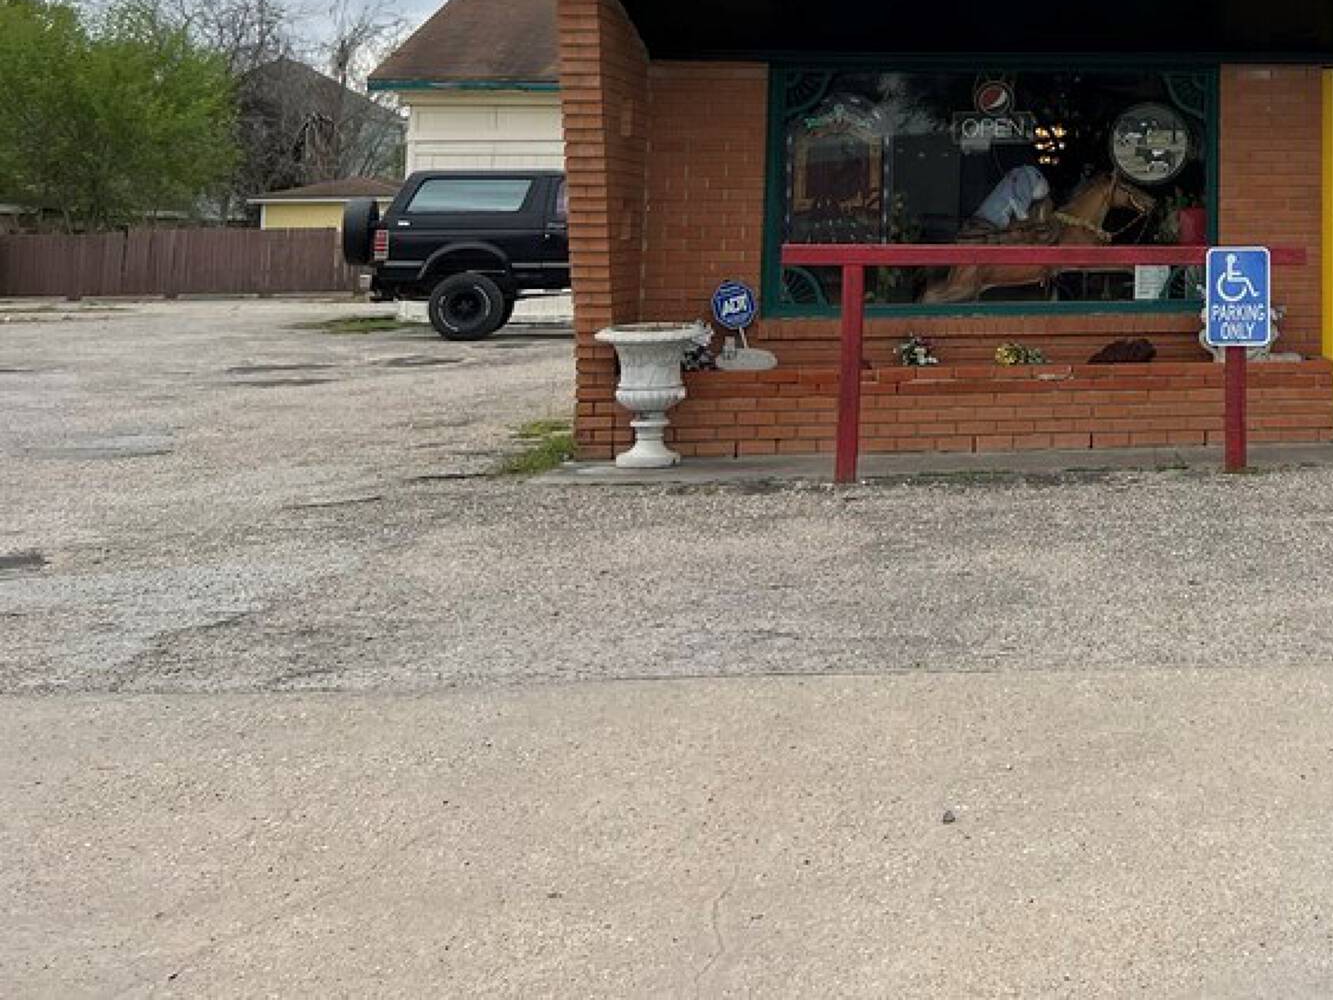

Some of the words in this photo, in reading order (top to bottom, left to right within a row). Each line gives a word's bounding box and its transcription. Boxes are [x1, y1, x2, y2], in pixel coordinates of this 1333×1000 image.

[961, 116, 1025, 138] OPEN
[721, 294, 748, 316] ADT
[1212, 302, 1265, 321] PARKING
[1220, 321, 1255, 340] ONLY
